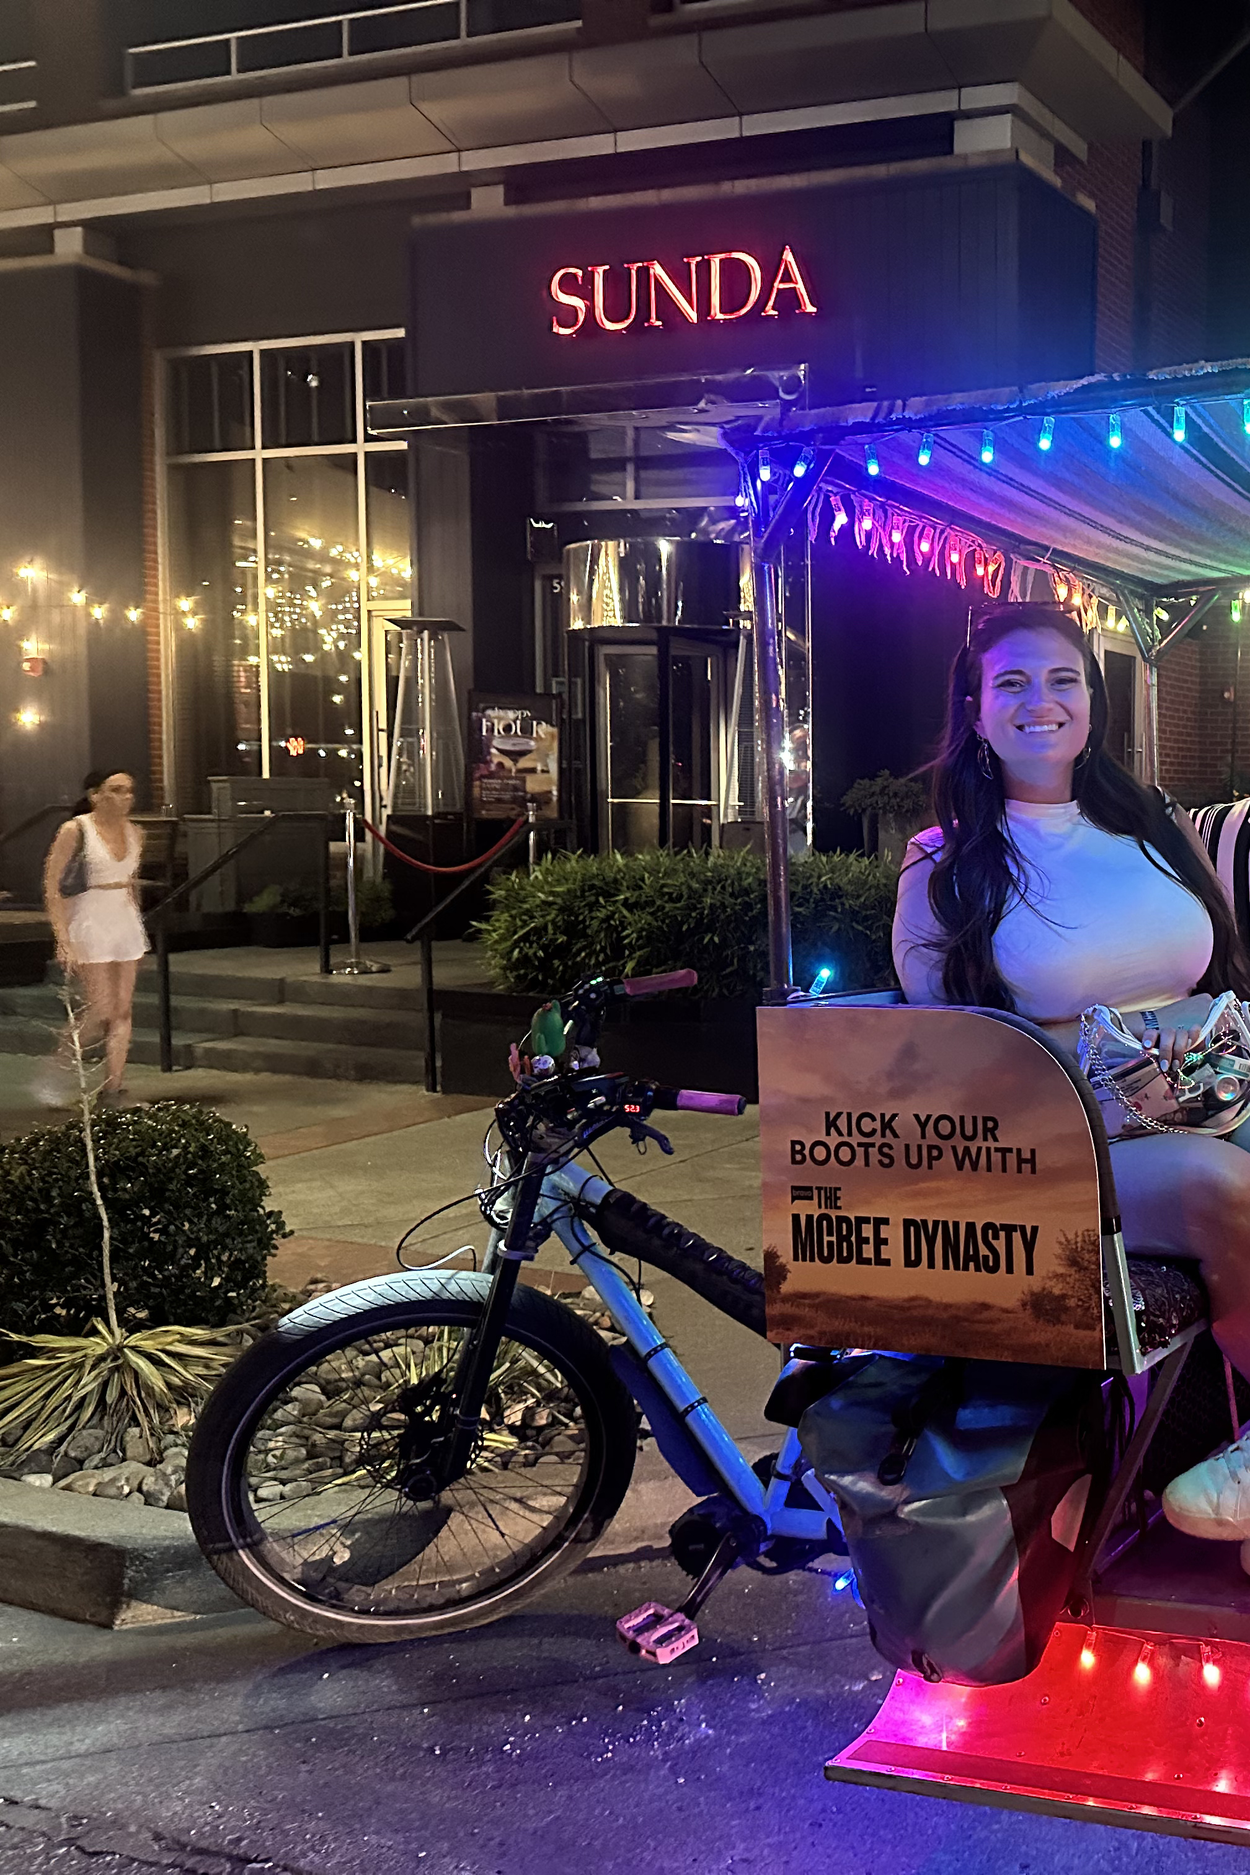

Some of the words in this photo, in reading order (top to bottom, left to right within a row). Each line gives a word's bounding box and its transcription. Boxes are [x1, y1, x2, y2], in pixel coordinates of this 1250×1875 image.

[550, 244, 818, 336] SUNDA
[482, 718, 546, 738] HOUR
[825, 1111, 900, 1138] KICK
[913, 1113, 999, 1142] YOUR
[790, 1140, 895, 1168] BOOTS
[904, 1143, 943, 1170] UP
[951, 1145, 1037, 1174] WITH
[815, 1186, 842, 1210] THE
[791, 1213, 891, 1266] MCBEE
[903, 1218, 1039, 1276] DYNASTY
